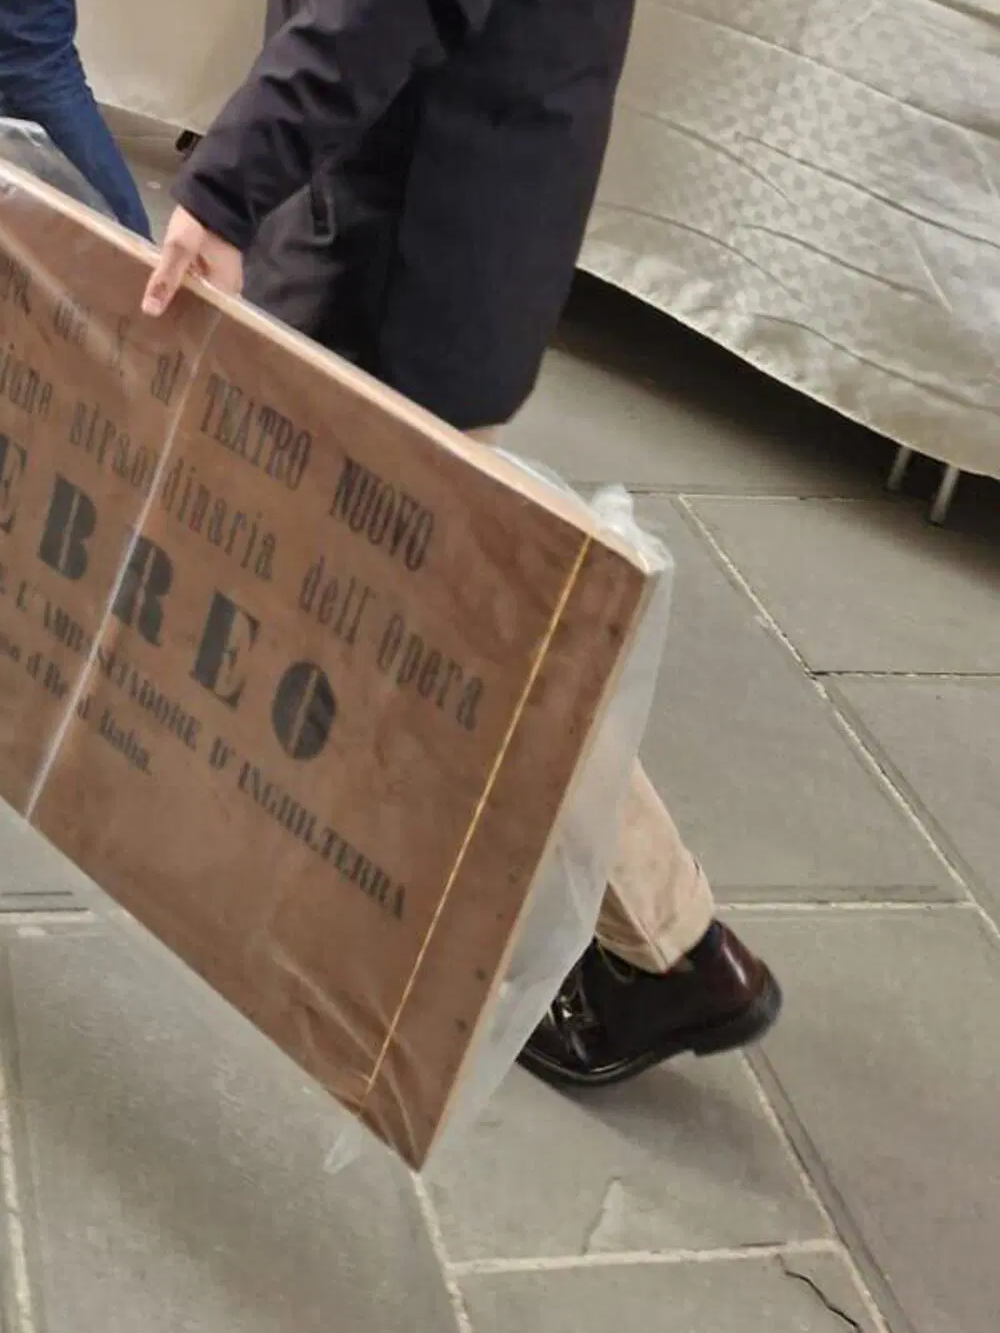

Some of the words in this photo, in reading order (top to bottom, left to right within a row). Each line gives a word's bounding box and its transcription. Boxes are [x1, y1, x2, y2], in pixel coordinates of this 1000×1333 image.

[197, 372, 313, 492] TEATRO
[328, 456, 438, 574] NUOVO
[42, 599, 198, 753] AMBSCIADORE
